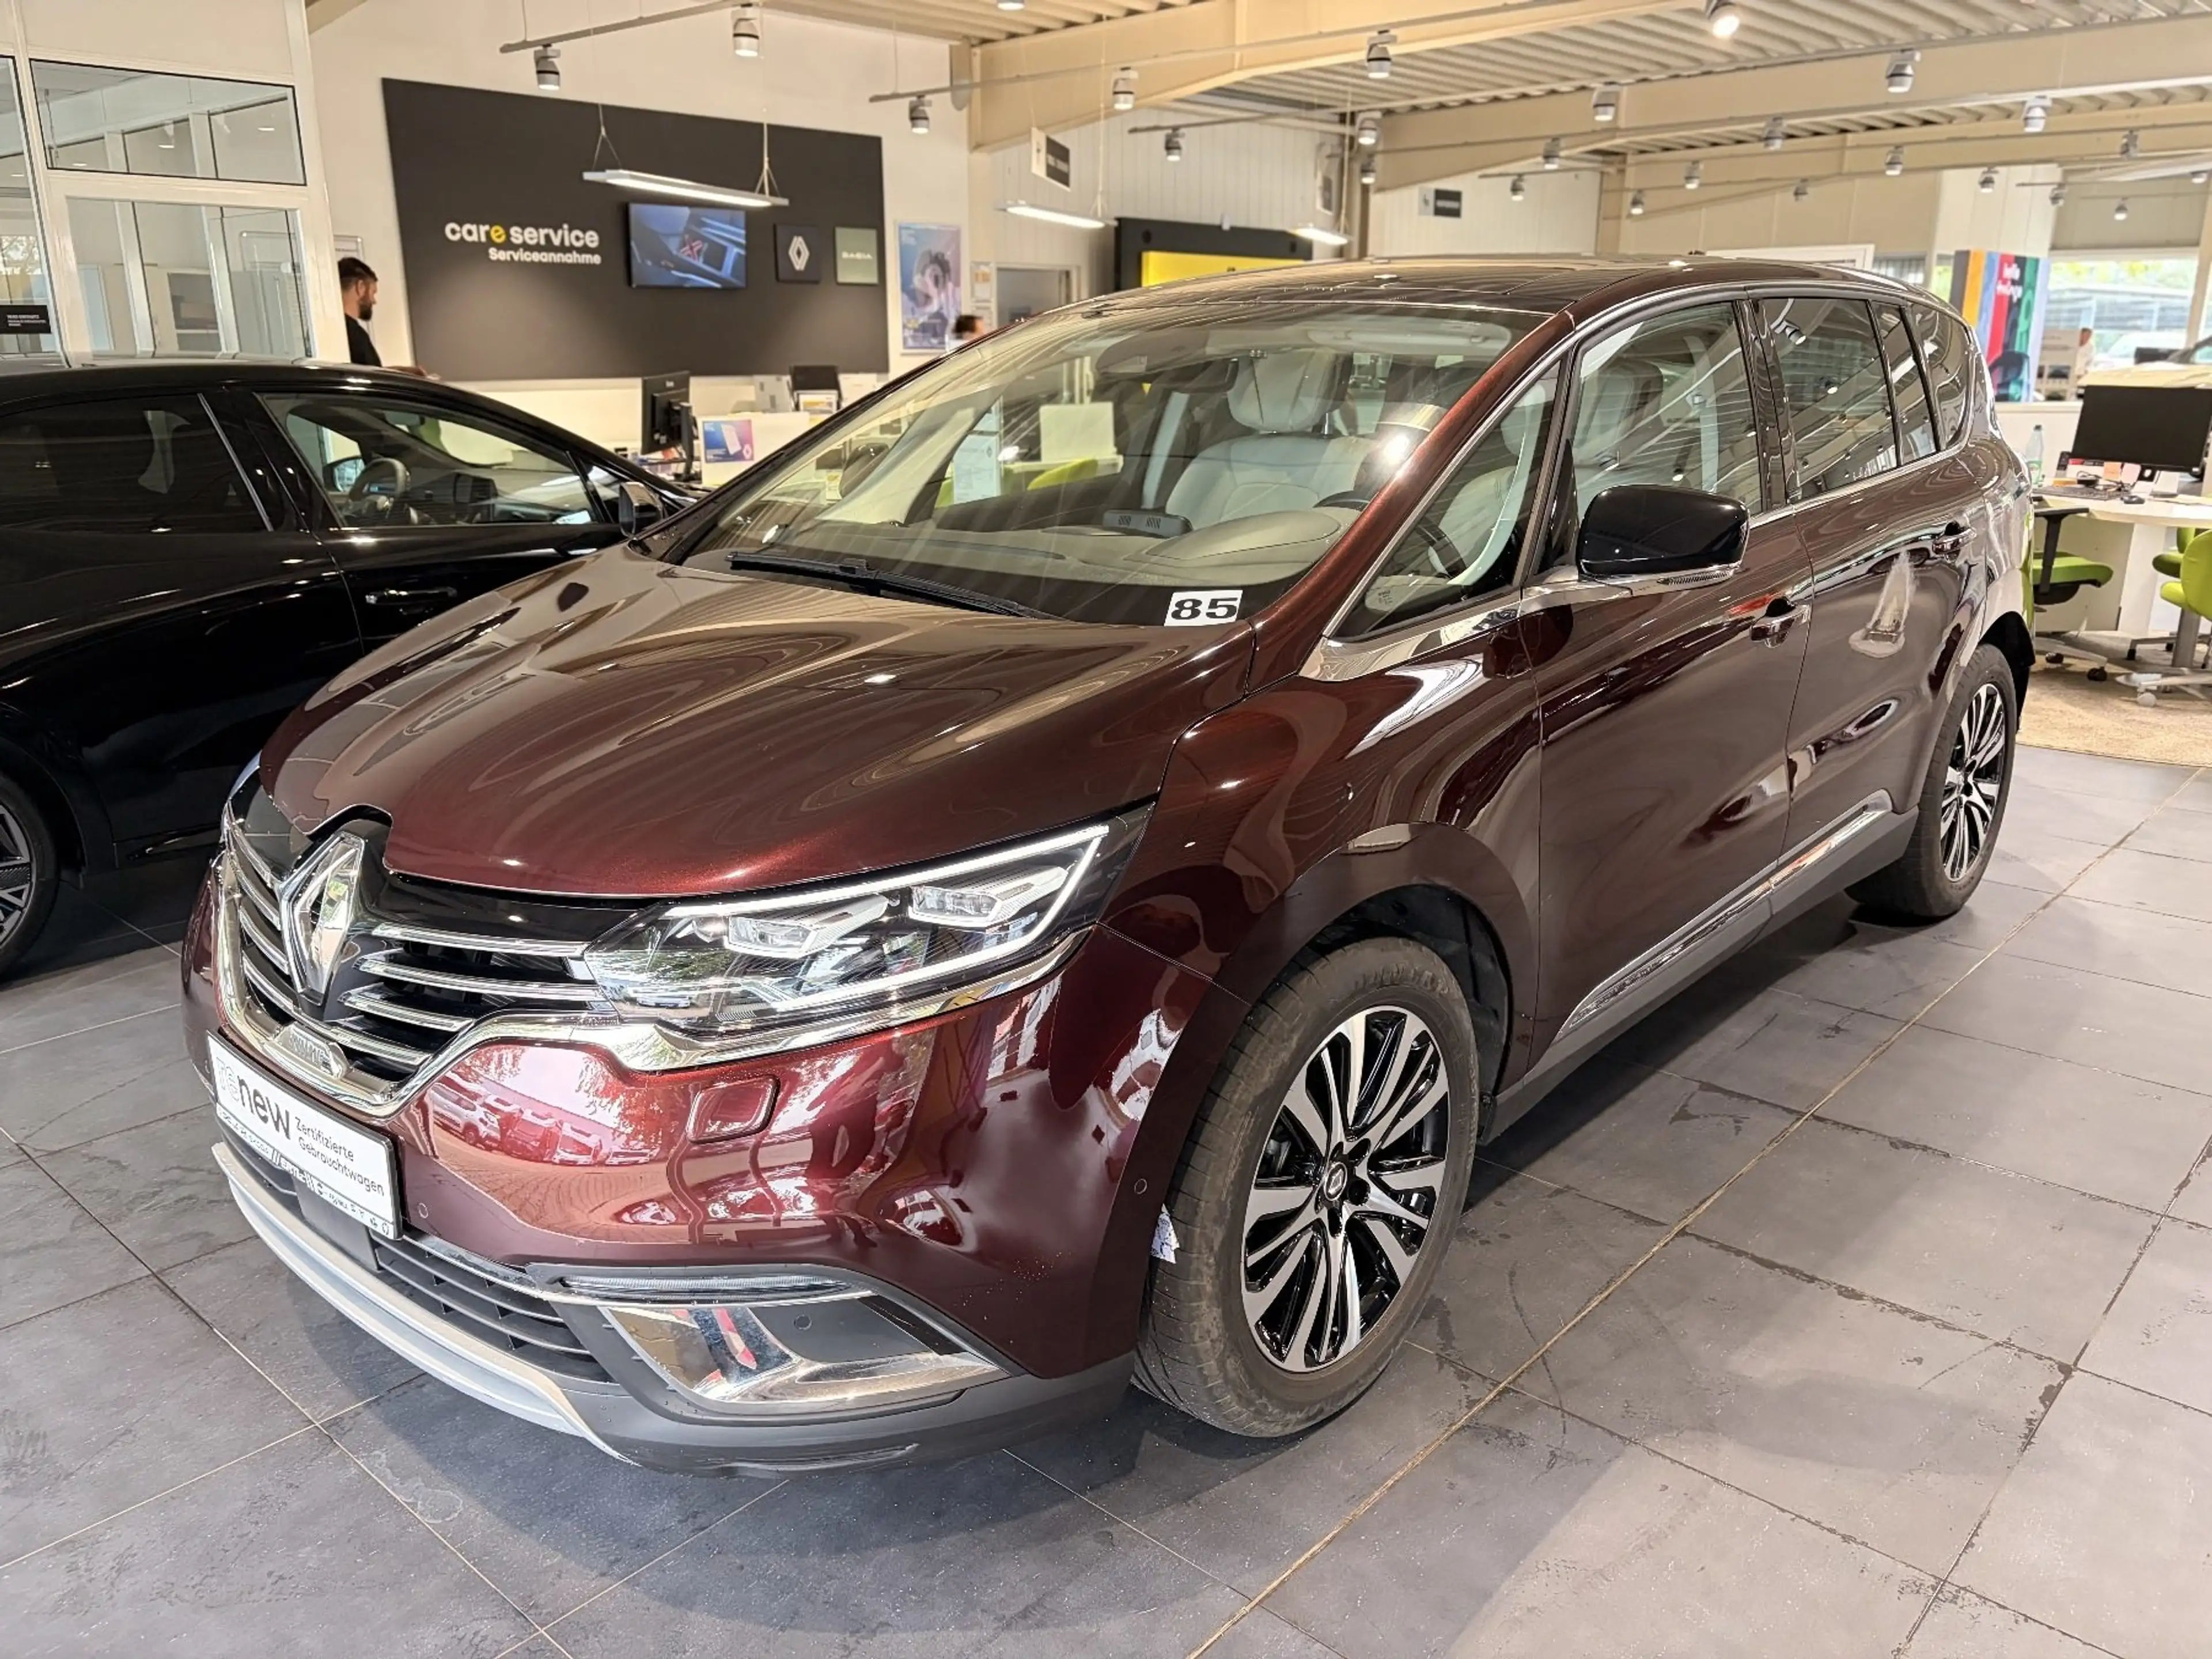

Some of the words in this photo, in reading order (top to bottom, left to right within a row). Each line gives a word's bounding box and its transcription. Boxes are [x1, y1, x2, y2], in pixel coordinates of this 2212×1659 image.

[445, 222, 506, 243] care
[509, 224, 599, 248] service
[488, 247, 601, 264] Serviceannahme
[1171, 597, 1238, 620] 85
[295, 1116, 354, 1162] Zertifizierte
[298, 1137, 384, 1196] Gebrauchtwagen
